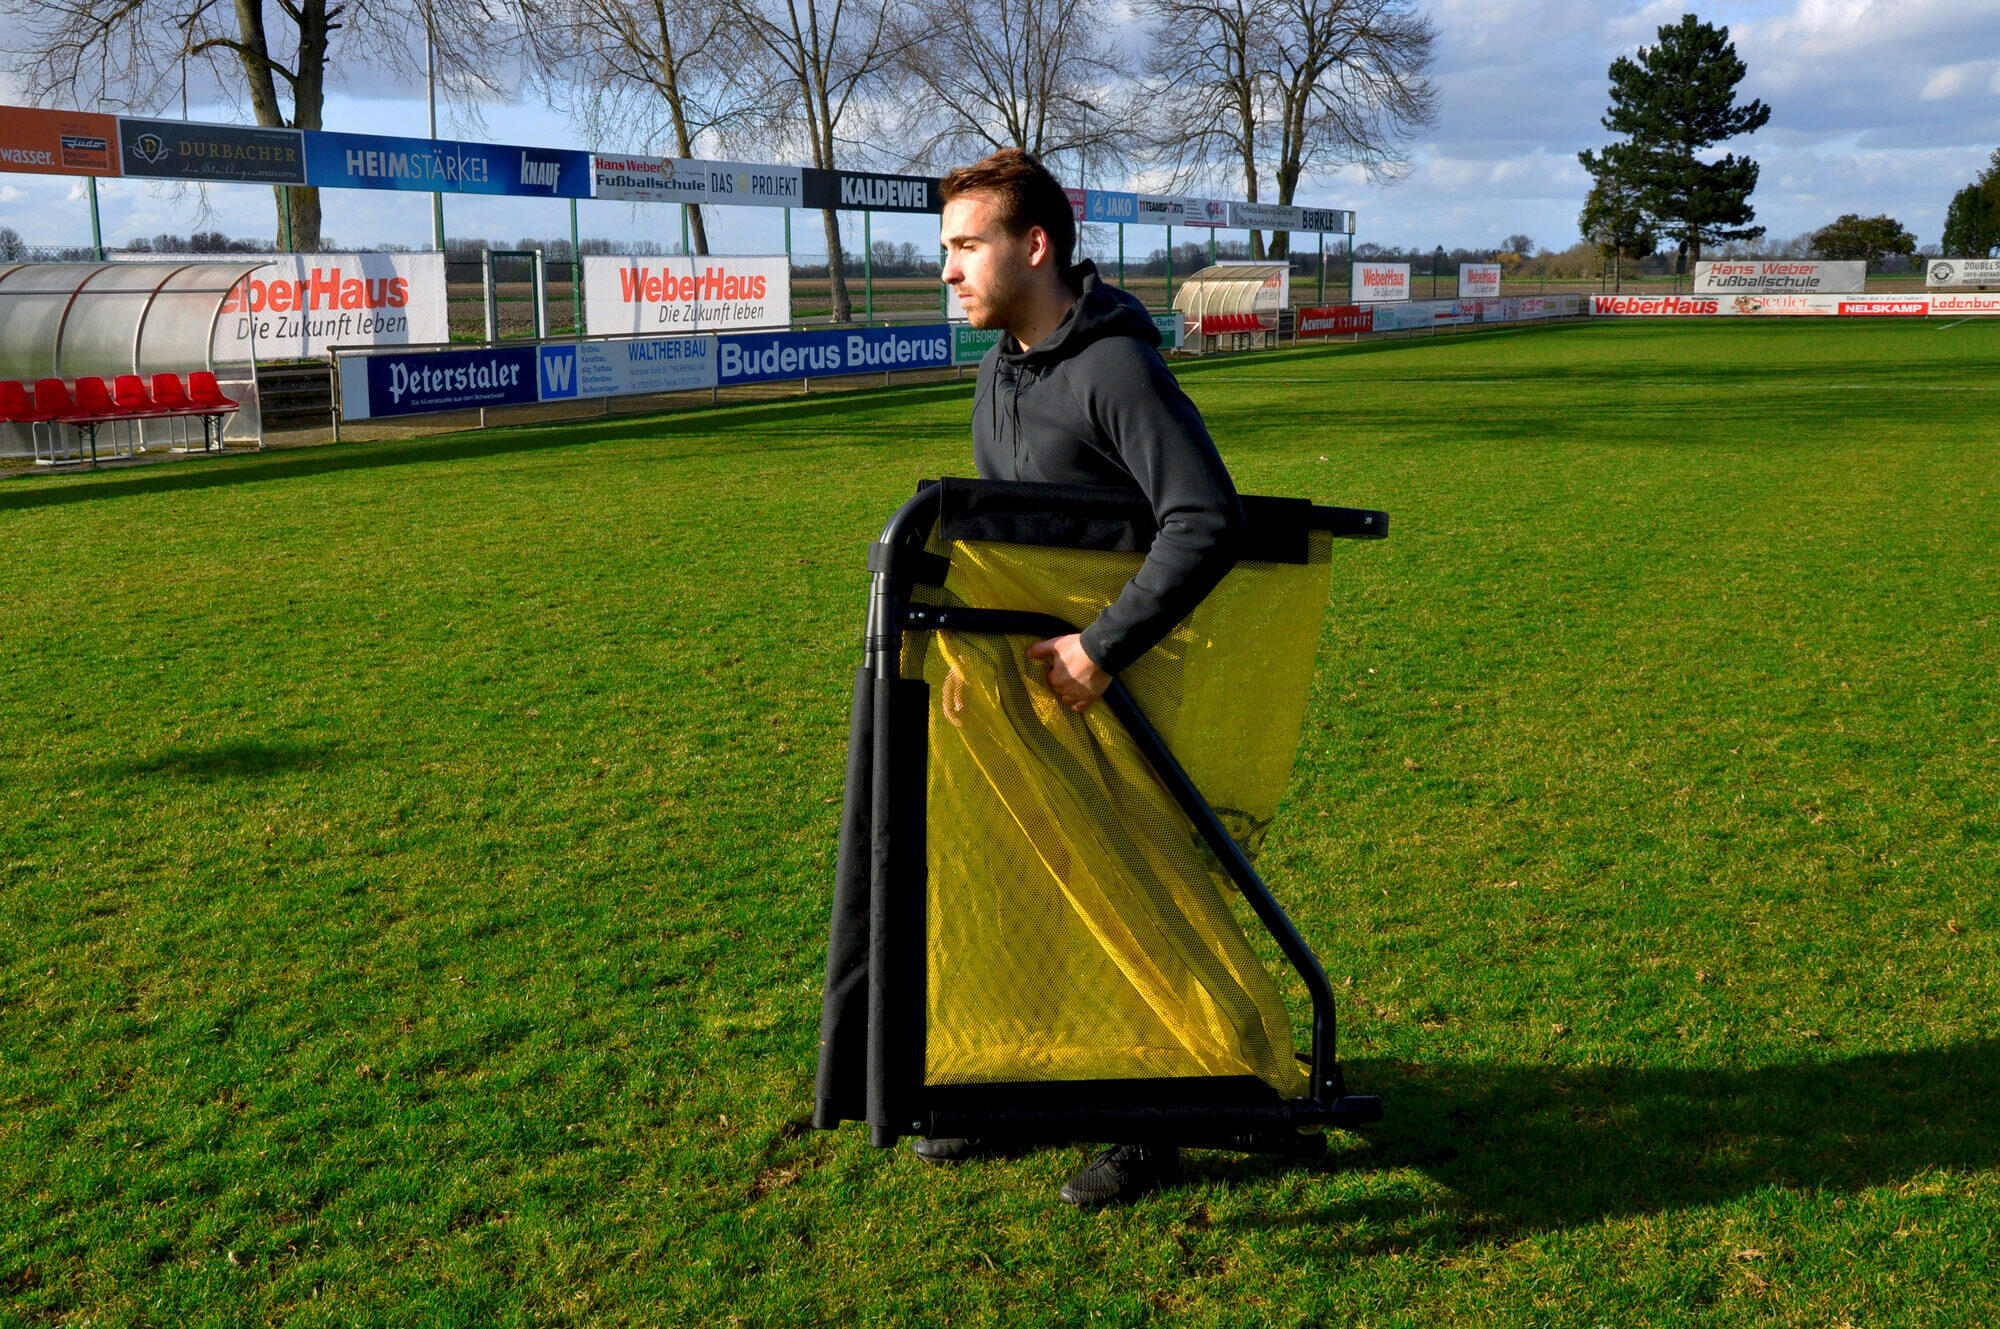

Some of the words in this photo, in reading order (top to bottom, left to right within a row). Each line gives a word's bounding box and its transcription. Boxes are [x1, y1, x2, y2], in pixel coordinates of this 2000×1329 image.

[0, 147, 56, 166] wasser.
[178, 140, 297, 163] DURBACHER
[346, 149, 489, 183] HEIMSTÄRKE!
[596, 157, 625, 171] Hans
[626, 159, 662, 173] Weber
[596, 174, 706, 191] Fußballschule
[711, 173, 733, 194] DAS
[752, 175, 798, 197] PROJEKT
[840, 176, 928, 208] KALDEWEI
[1106, 197, 1132, 217] JAKO
[1302, 210, 1334, 231] BÜRKLE
[1363, 268, 1406, 287] WeberHaus
[1467, 268, 1498, 285] WeberHaus
[1711, 263, 1754, 275] Hans
[1762, 263, 1819, 275] Weber
[218, 267, 409, 314] eberHaus
[619, 267, 767, 303] WeberHaus
[1707, 275, 1821, 288] Fußballschule
[658, 304, 680, 324] Die
[683, 302, 731, 325] Zukunft
[733, 302, 764, 320] leben
[1595, 296, 1720, 315] WeberHaus
[1845, 304, 1923, 313] NELSKAMP
[1931, 296, 2000, 309] Ladenbur
[236, 316, 271, 340] Die
[276, 314, 352, 341] Zukunft
[356, 311, 408, 335] leben
[628, 341, 682, 362] WALTHER
[684, 339, 706, 358] BAU
[720, 341, 841, 377] Buderus
[847, 334, 948, 367] Buderus
[544, 355, 574, 393] W
[592, 364, 613, 373] Tiefbau
[389, 359, 521, 404] Peterstaler
